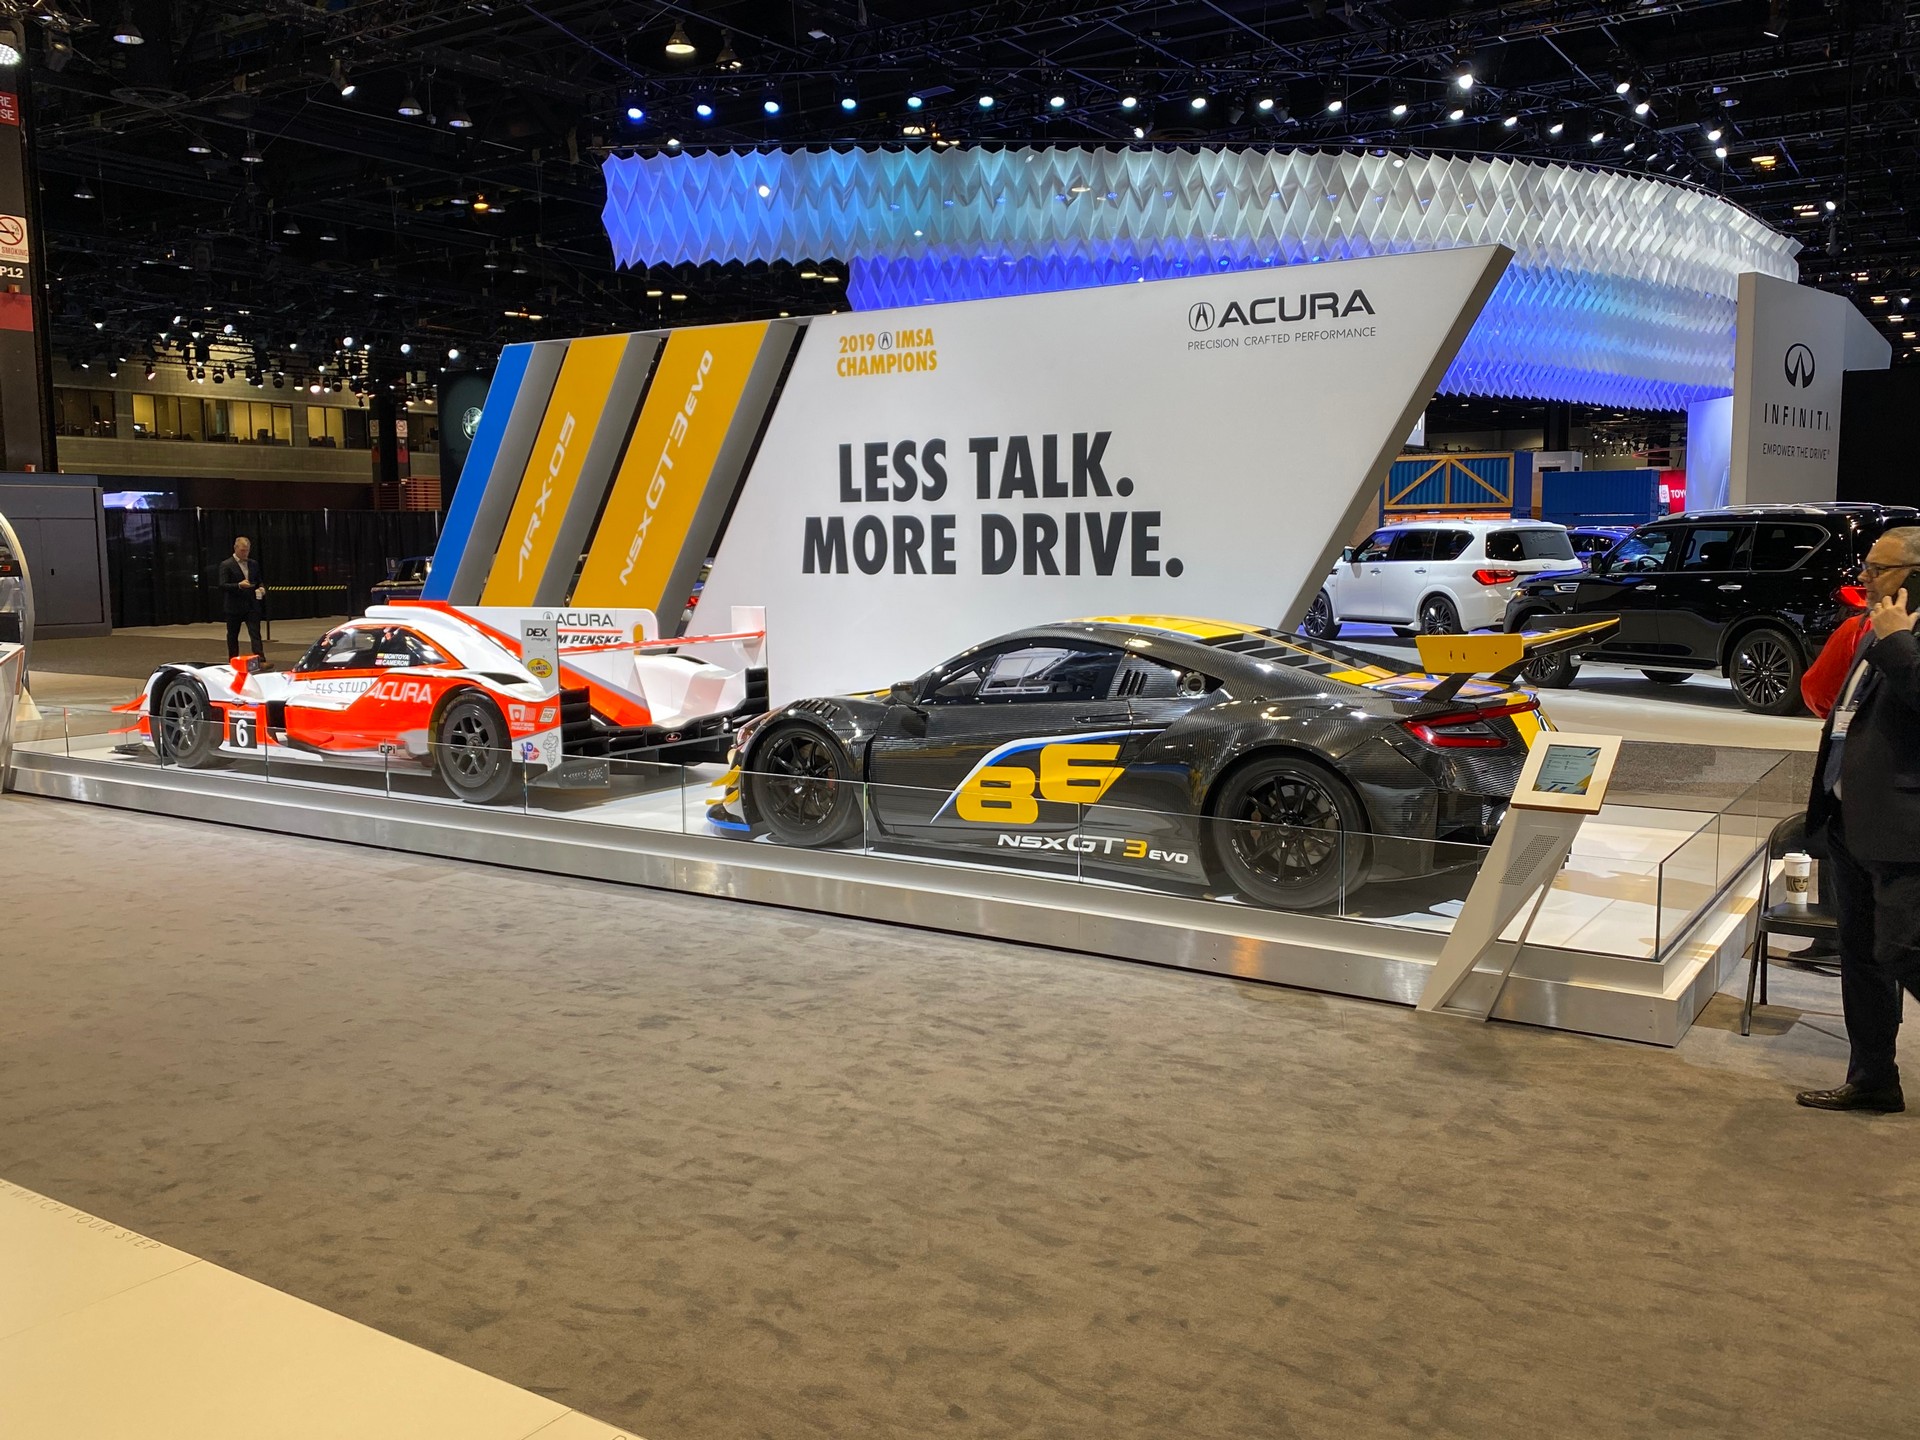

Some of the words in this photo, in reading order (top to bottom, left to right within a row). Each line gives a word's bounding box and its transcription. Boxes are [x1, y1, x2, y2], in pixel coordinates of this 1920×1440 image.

[1217, 289, 1376, 328] ACURA
[839, 333, 875, 354] 2019
[895, 327, 934, 349] IMSA
[1188, 338, 1239, 350] PRECISION
[1244, 333, 1290, 346] CRAFTED
[1294, 327, 1376, 342] PERFORMANCE
[836, 349, 938, 377] CHAMPIONS
[1763, 403, 1829, 431] INFINITI
[1763, 443, 1795, 458] EMPOWER
[1797, 446, 1809, 459] THE
[839, 437, 948, 502] LESS
[968, 431, 1135, 499] TALK.
[802, 514, 957, 575] MORE
[981, 510, 1184, 578] DRIVE.
[526, 628, 549, 637] DEX
[557, 613, 614, 627] ACURA
[570, 635, 622, 644] PENSKE
[315, 682, 334, 694] ELS
[365, 681, 433, 705] ACURA
[236, 719, 248, 747] 6
[380, 745, 396, 754] DPi
[956, 743, 1125, 824] 86
[68, 1211, 116, 1233] YOUR
[115, 1231, 162, 1250] STEP
